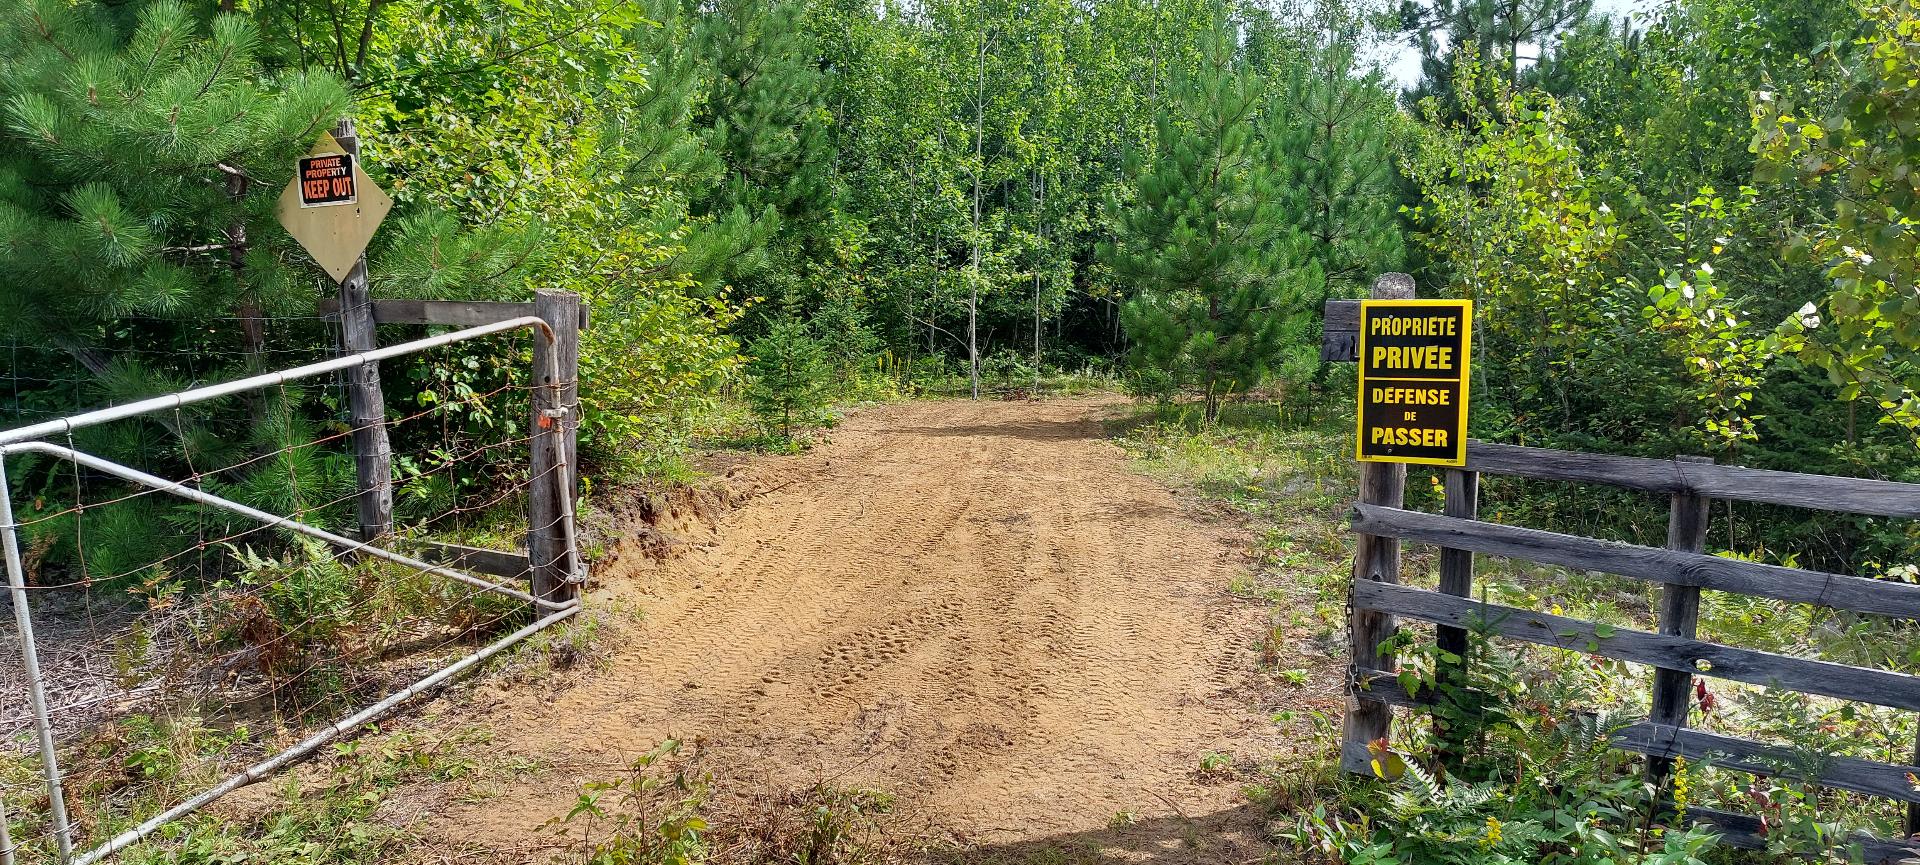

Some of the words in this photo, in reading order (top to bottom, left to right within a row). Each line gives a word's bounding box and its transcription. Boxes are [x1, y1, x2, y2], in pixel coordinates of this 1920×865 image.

[310, 158, 341, 168] PRIVATE
[306, 167, 346, 178] PROPERTY
[304, 180, 329, 199] KEEP
[333, 177, 351, 196] OUT
[1404, 411, 1417, 421] DE
[1371, 427, 1448, 447] PASSER
